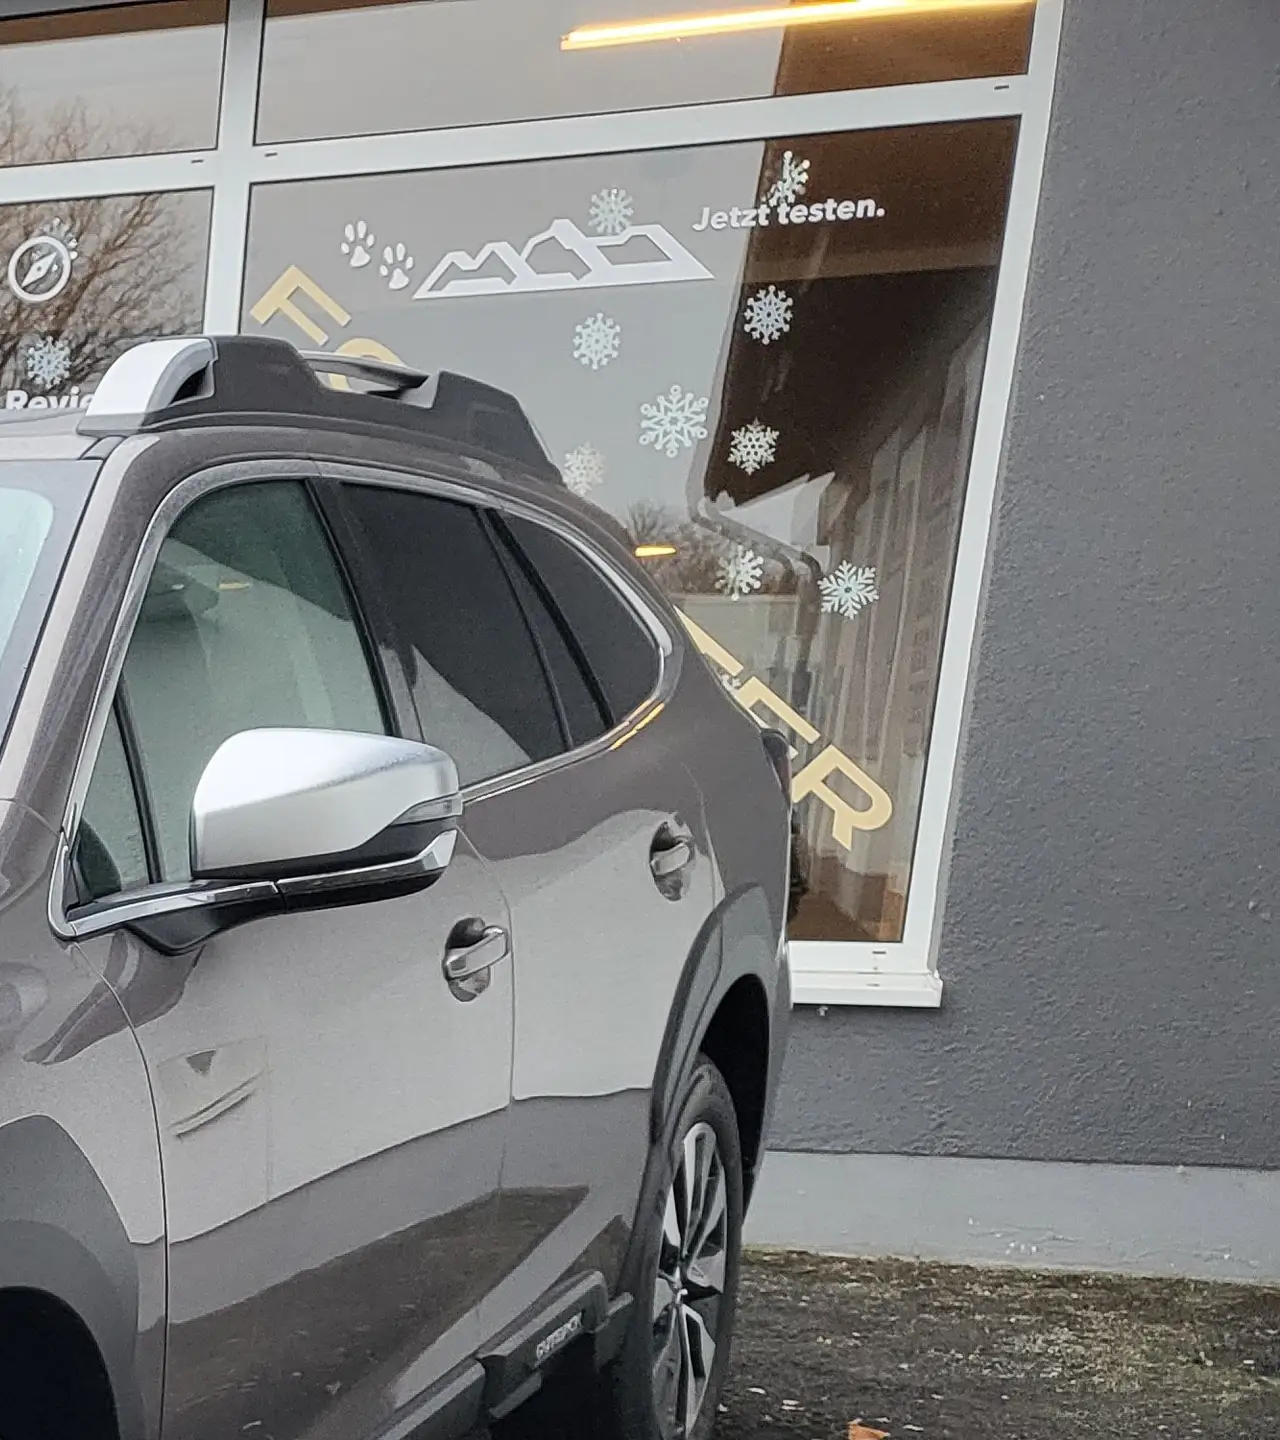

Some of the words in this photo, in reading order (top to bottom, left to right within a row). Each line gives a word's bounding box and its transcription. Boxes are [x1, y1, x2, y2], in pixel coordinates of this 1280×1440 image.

[692, 204, 771, 232] Jetzt
[777, 198, 886, 225] testen.
[5, 385, 98, 411] Revie
